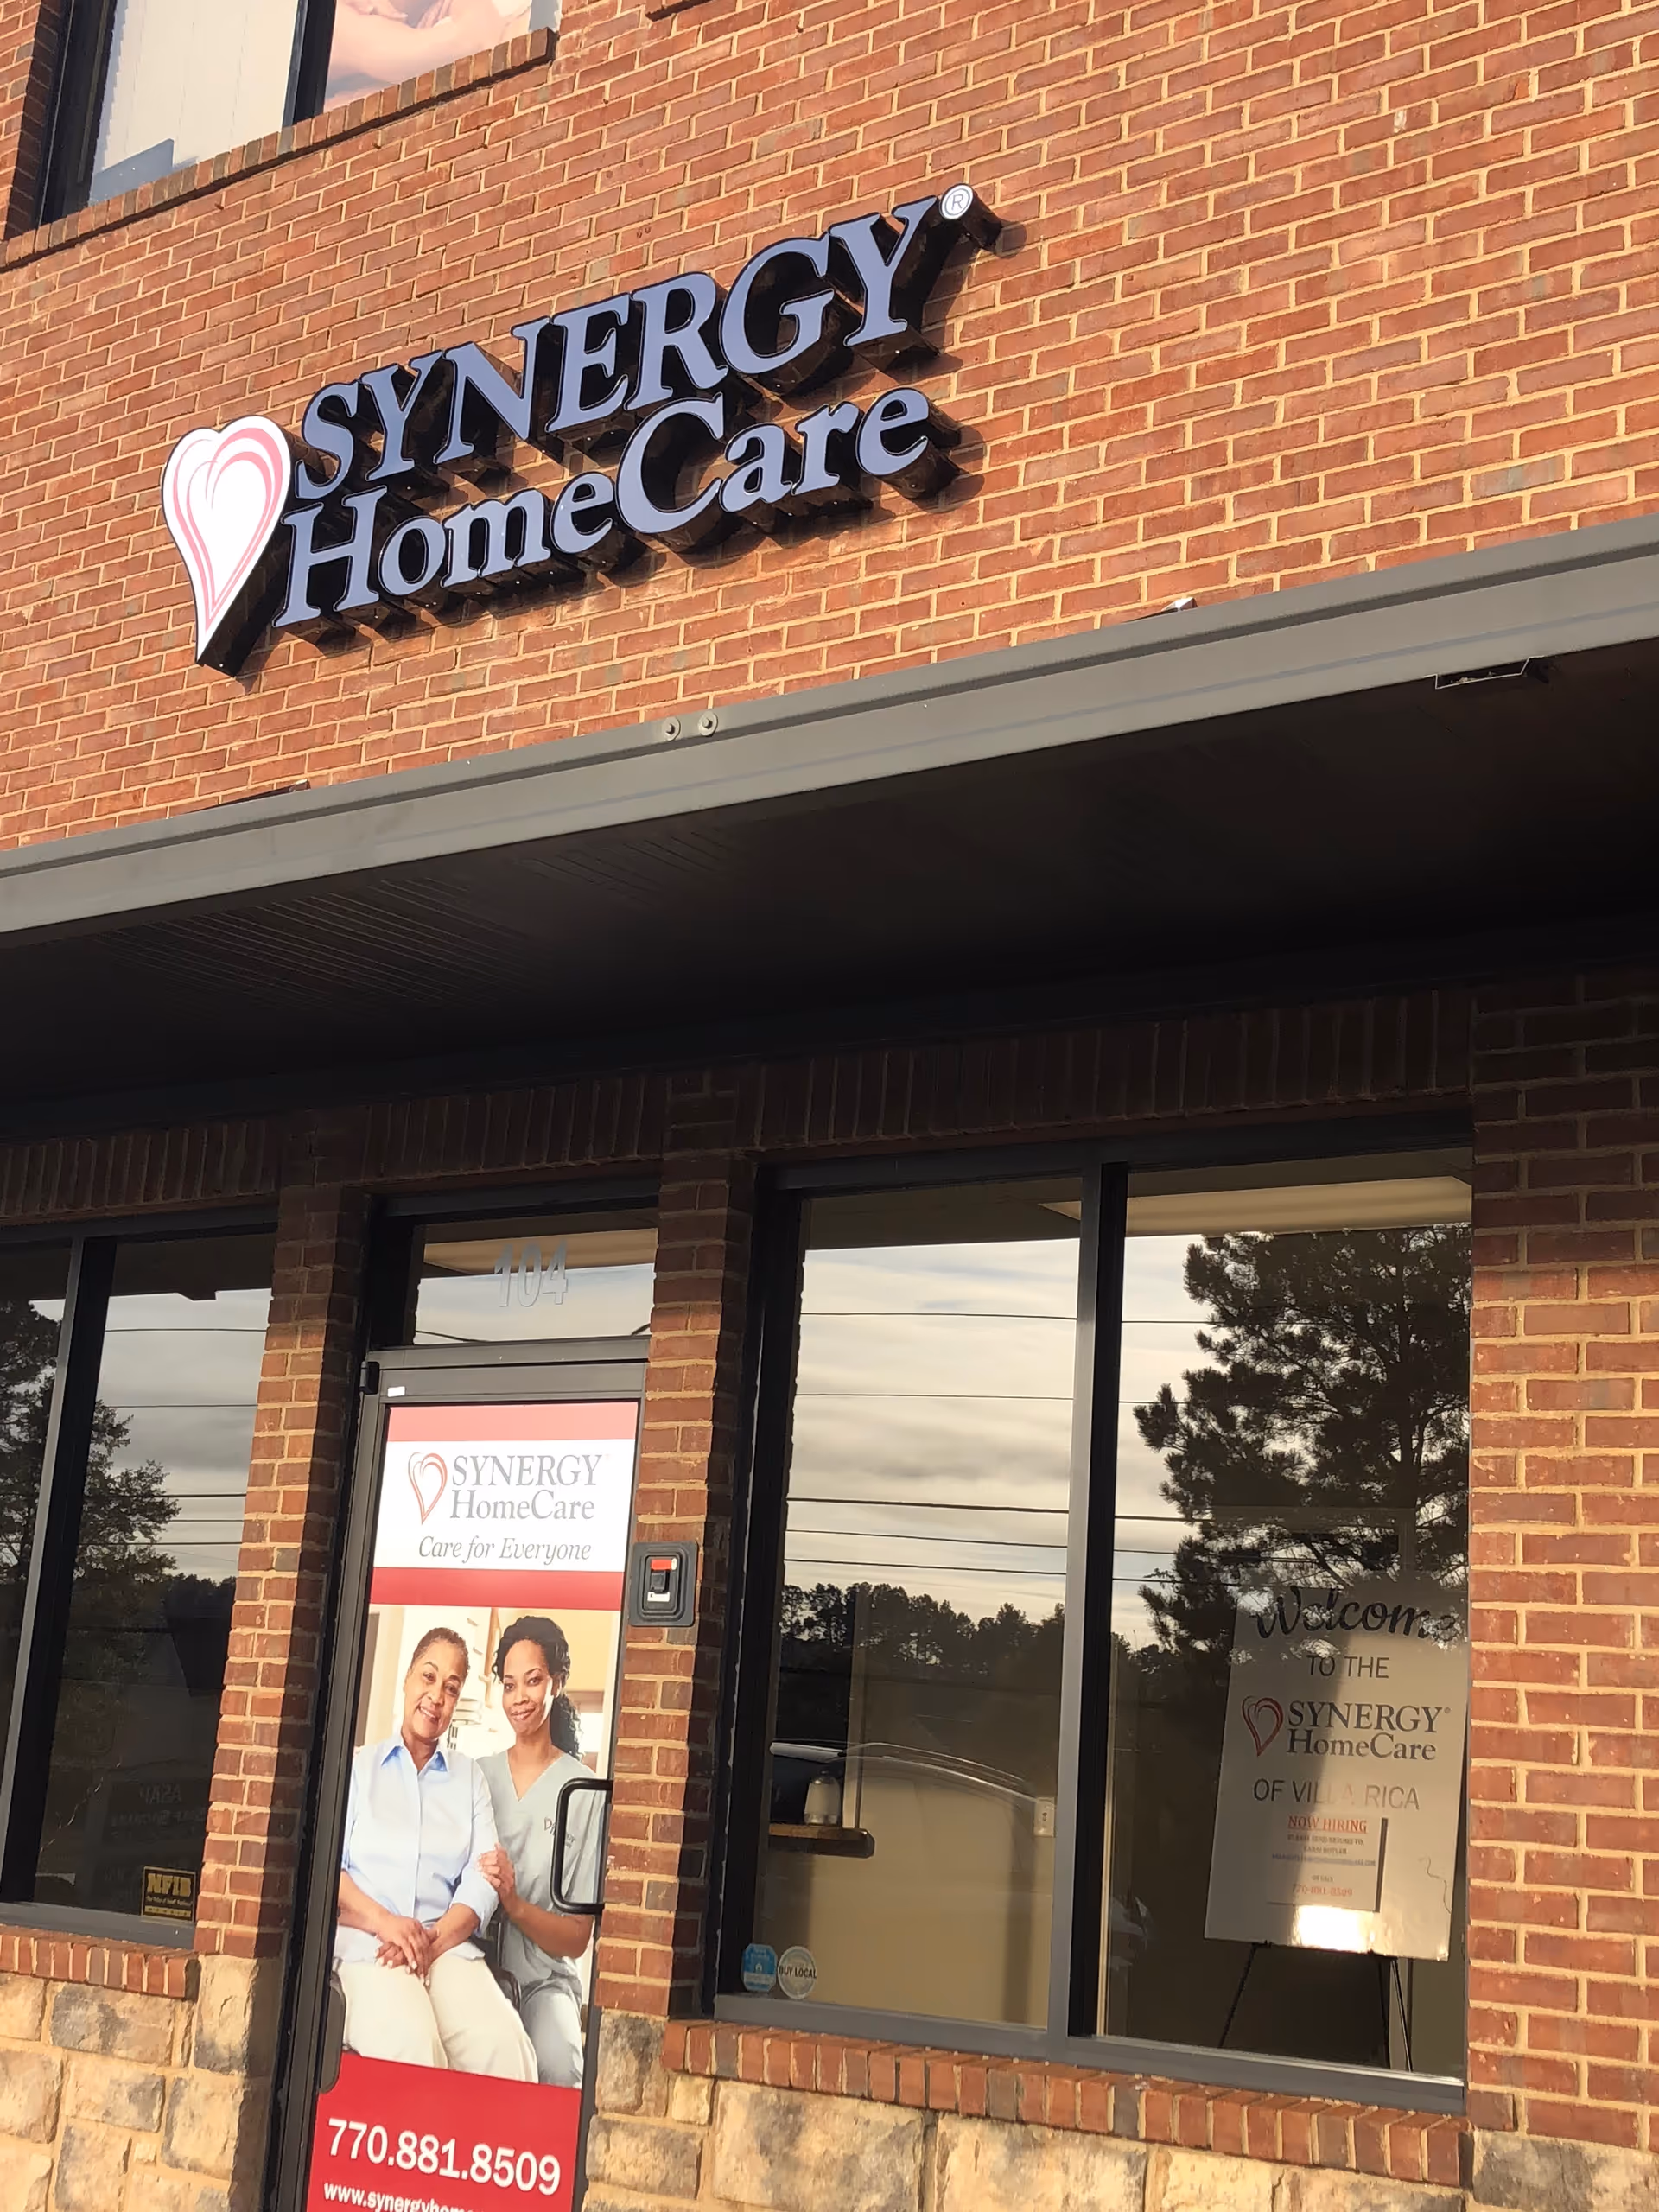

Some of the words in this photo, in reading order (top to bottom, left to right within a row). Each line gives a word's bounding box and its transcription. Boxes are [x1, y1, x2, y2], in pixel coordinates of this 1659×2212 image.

[295, 195, 938, 500] SYNERGY
[273, 386, 930, 628] HomeCare
[494, 1239, 569, 1307] 104
[451, 1454, 603, 1486] SYNERGY
[449, 1489, 595, 1520] HomeCare
[419, 1535, 462, 1558] Care
[461, 1535, 495, 1564] for
[499, 1537, 591, 1566] Everyone
[1306, 1654, 1335, 1676] TO
[1344, 1656, 1390, 1678] THE
[1287, 1700, 1443, 1733] SYNERGY
[1286, 1728, 1436, 1760] HomeCare
[1253, 1777, 1286, 1802] OF
[1364, 1784, 1421, 1810] RICA
[1287, 1815, 1319, 1830] NOW
[1322, 1818, 1368, 1834] HIRING
[779, 1965, 793, 1977] BUY
[795, 1967, 817, 1980] LOCAL
[327, 2117, 561, 2196] 770.881.8509
